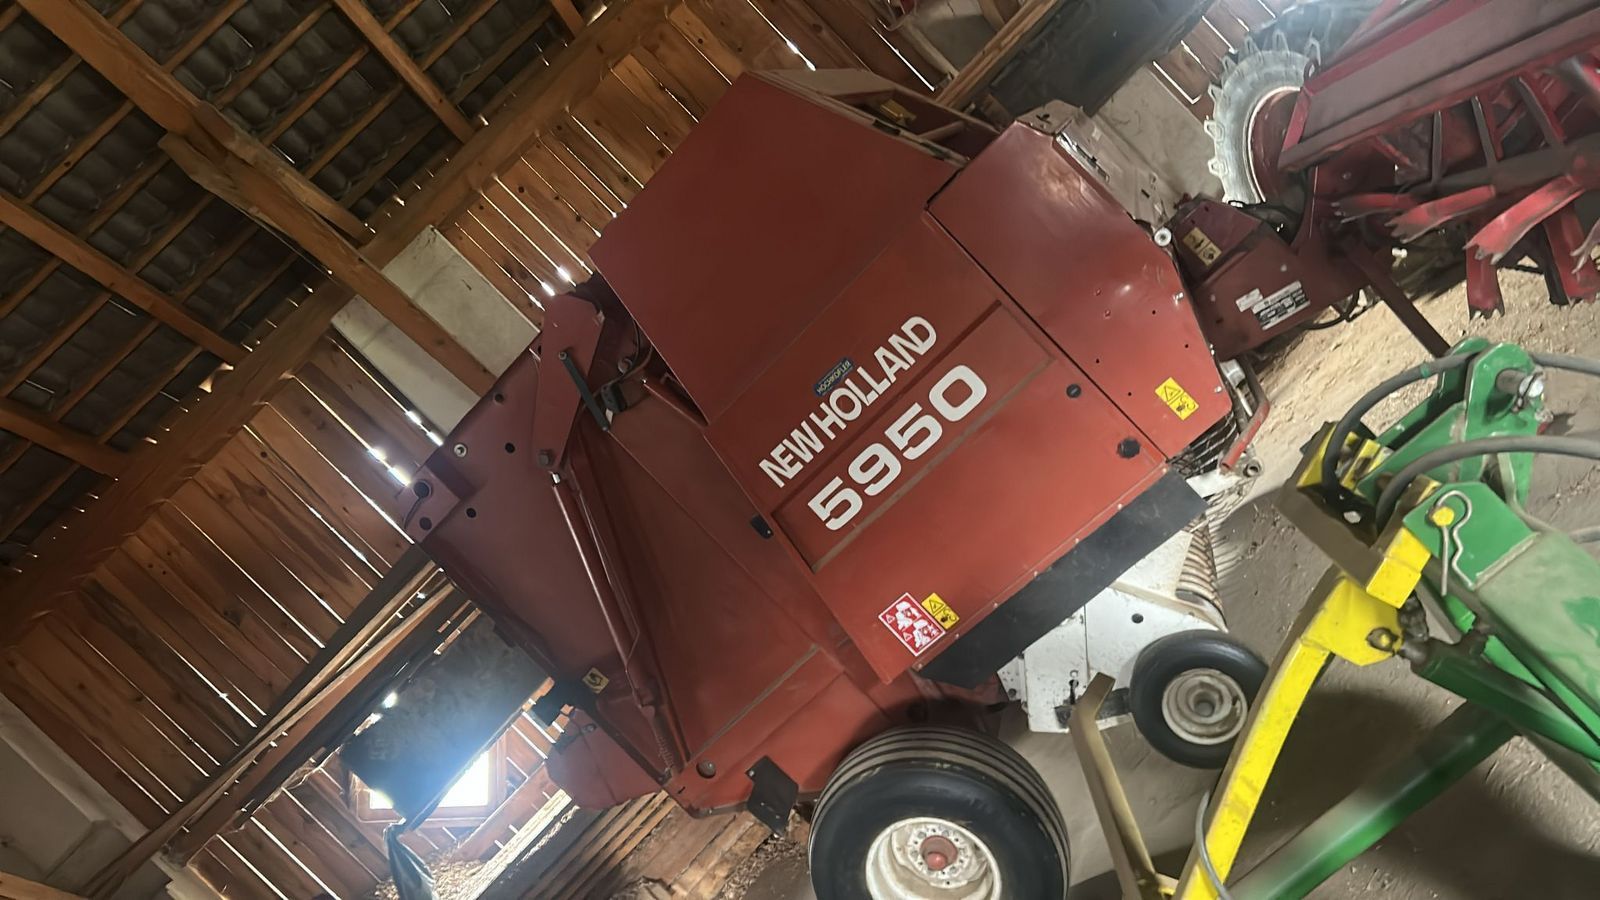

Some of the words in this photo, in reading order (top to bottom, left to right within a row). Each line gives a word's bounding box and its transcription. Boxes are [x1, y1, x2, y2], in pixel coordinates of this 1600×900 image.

[758, 421, 825, 488] NEW
[809, 316, 937, 441] HOLLAND
[807, 364, 988, 532] 5950
